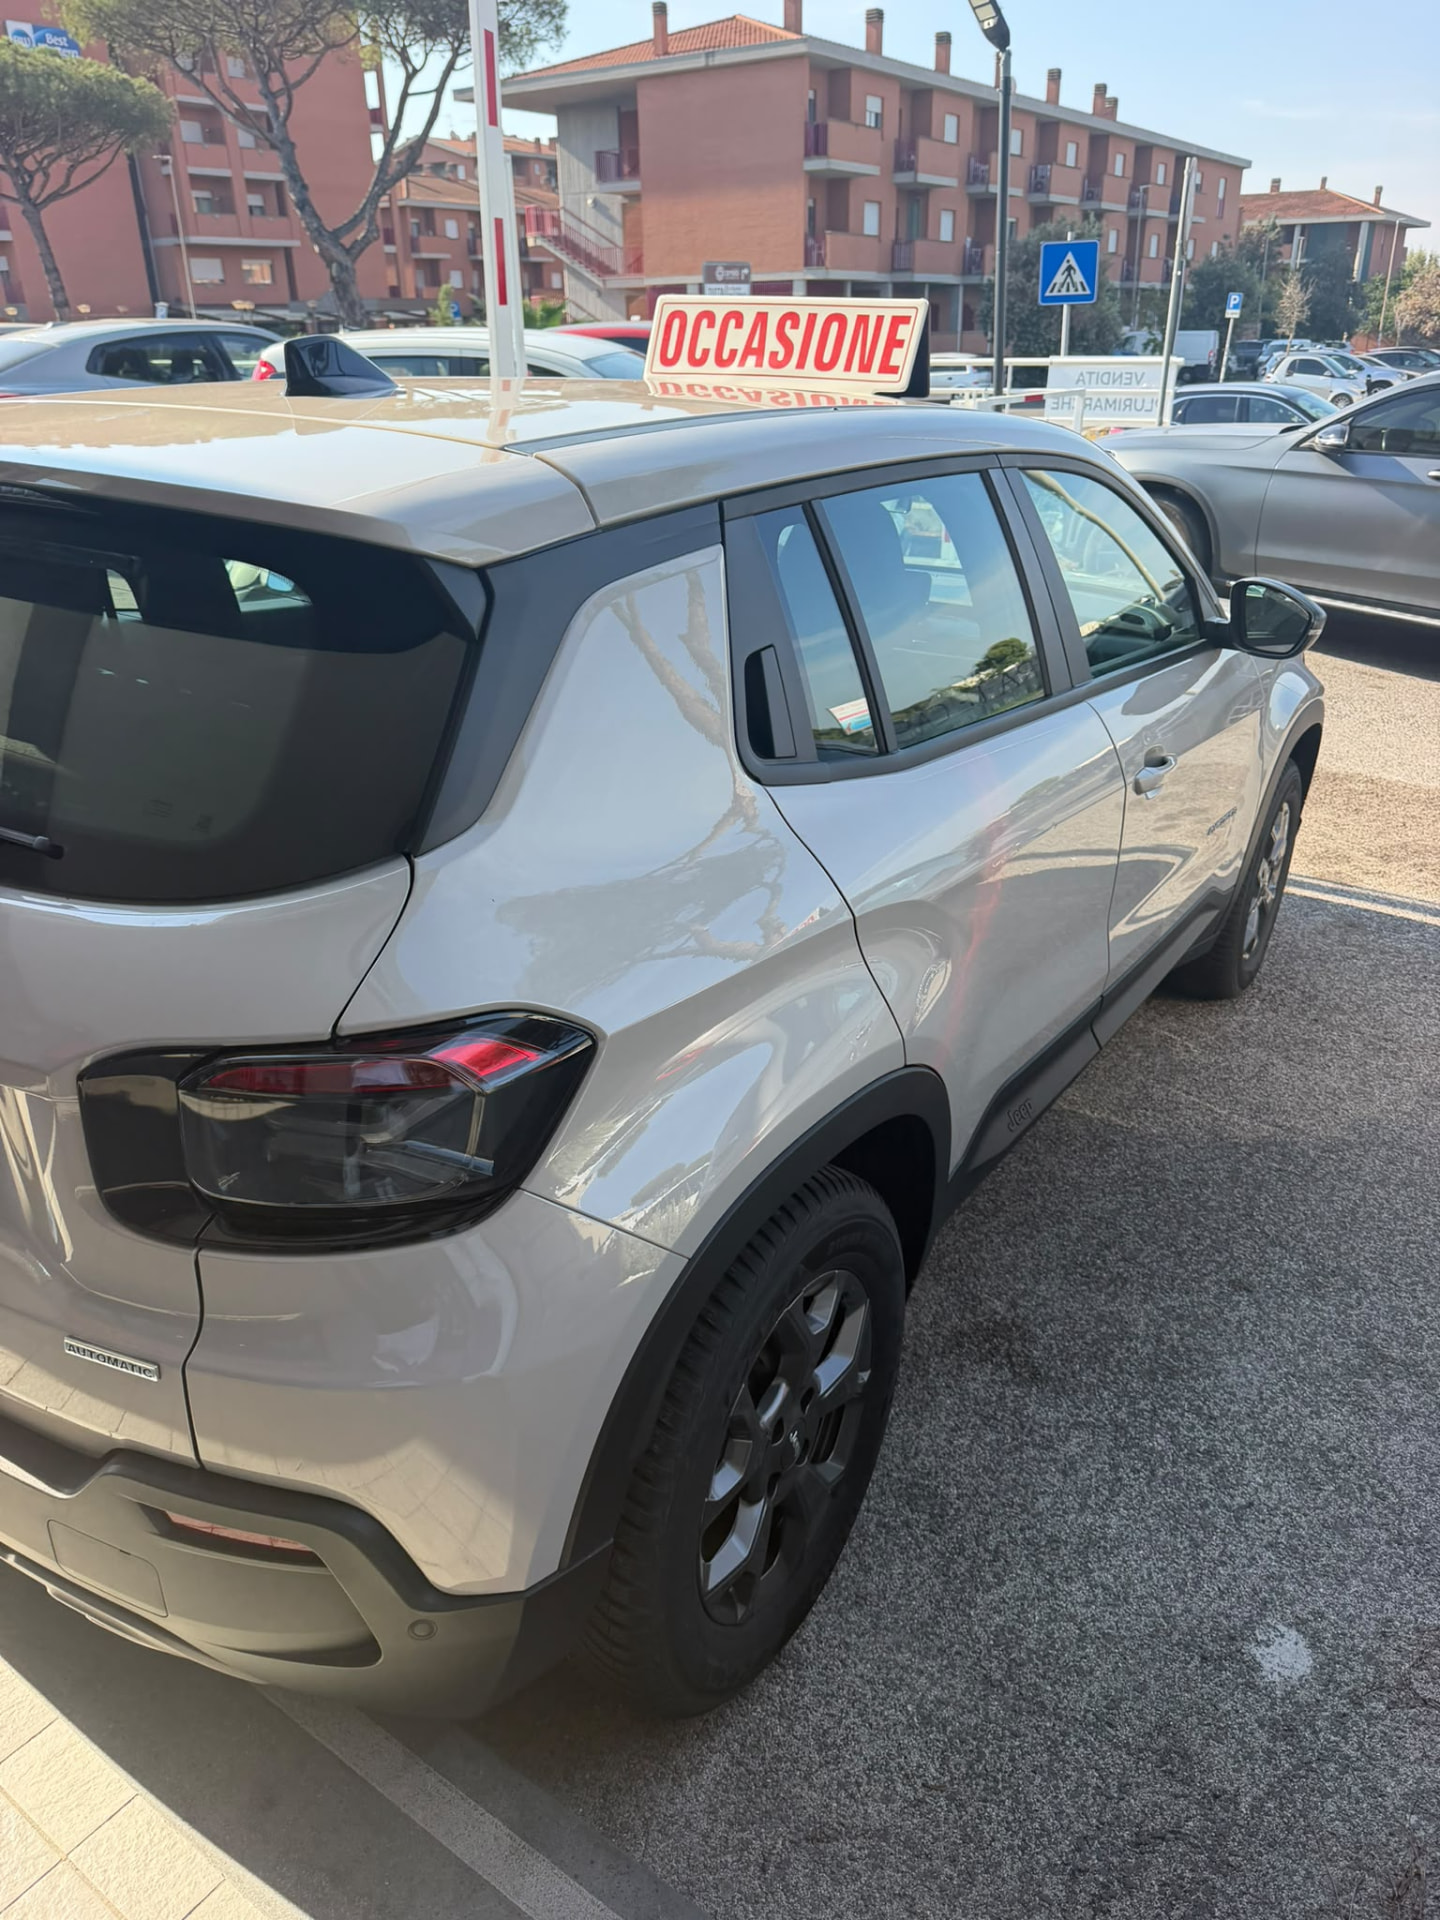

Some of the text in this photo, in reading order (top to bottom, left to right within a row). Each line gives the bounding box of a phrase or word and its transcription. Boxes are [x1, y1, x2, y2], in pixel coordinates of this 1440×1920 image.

[45, 33, 68, 47] Best
[1230, 295, 1240, 308] P
[659, 309, 912, 375] OCCASIONE
[67, 1343, 154, 1378] AUTOMATIC
